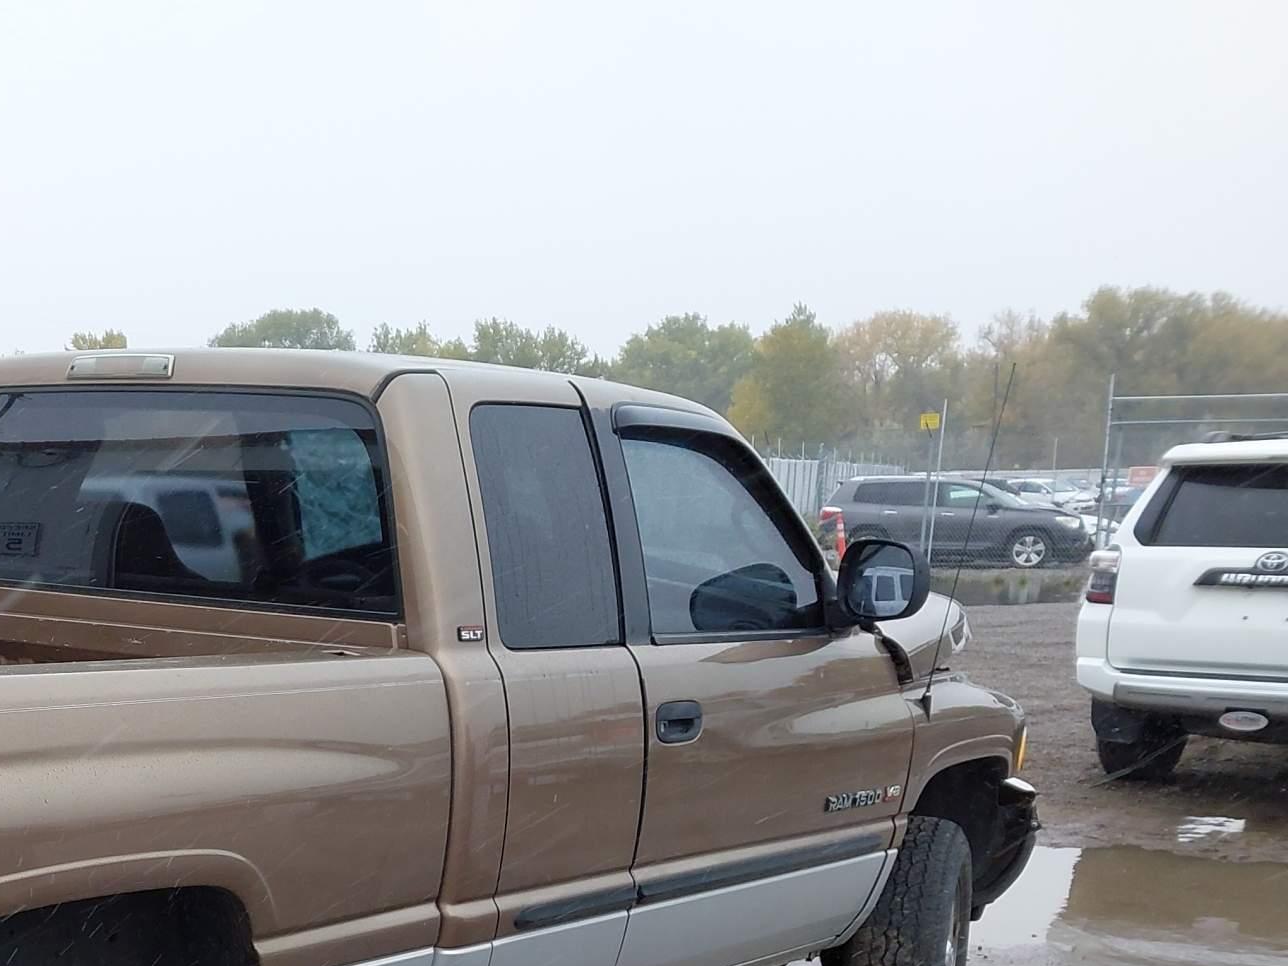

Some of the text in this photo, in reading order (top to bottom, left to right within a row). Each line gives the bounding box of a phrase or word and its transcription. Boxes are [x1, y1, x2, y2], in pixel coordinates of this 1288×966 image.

[461, 630, 483, 640] SLT
[827, 793, 853, 812] RAM
[855, 789, 882, 807] 1500
